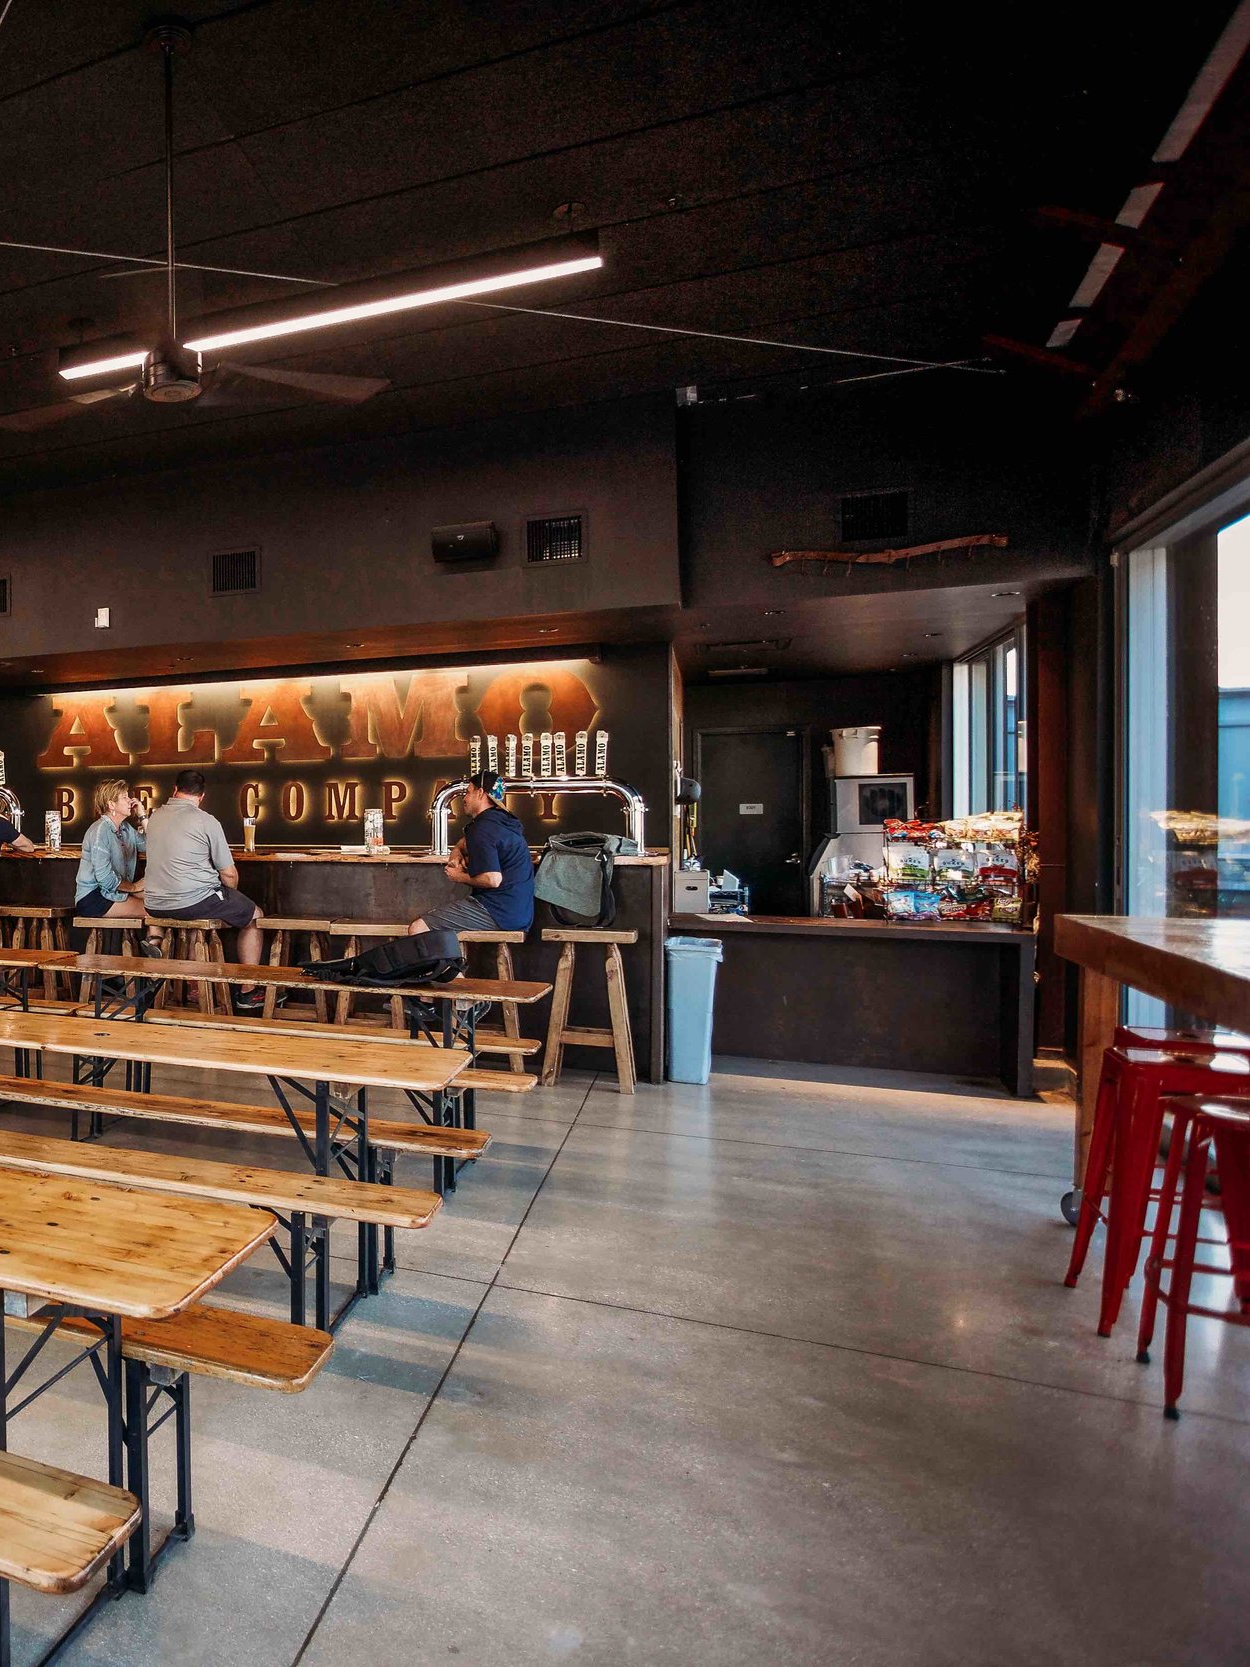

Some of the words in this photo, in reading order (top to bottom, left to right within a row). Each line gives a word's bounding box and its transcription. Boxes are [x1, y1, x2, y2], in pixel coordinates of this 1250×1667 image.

[37, 669, 600, 768] ALAMO
[490, 746, 498, 774] ALAMO
[523, 745, 531, 773] ALAMO
[542, 744, 551, 772] ALAMO
[556, 744, 565, 772] ALAMO
[577, 743, 586, 771] ALAMO
[597, 742, 606, 771] ALAMO
[238, 778, 559, 821] COMPY
